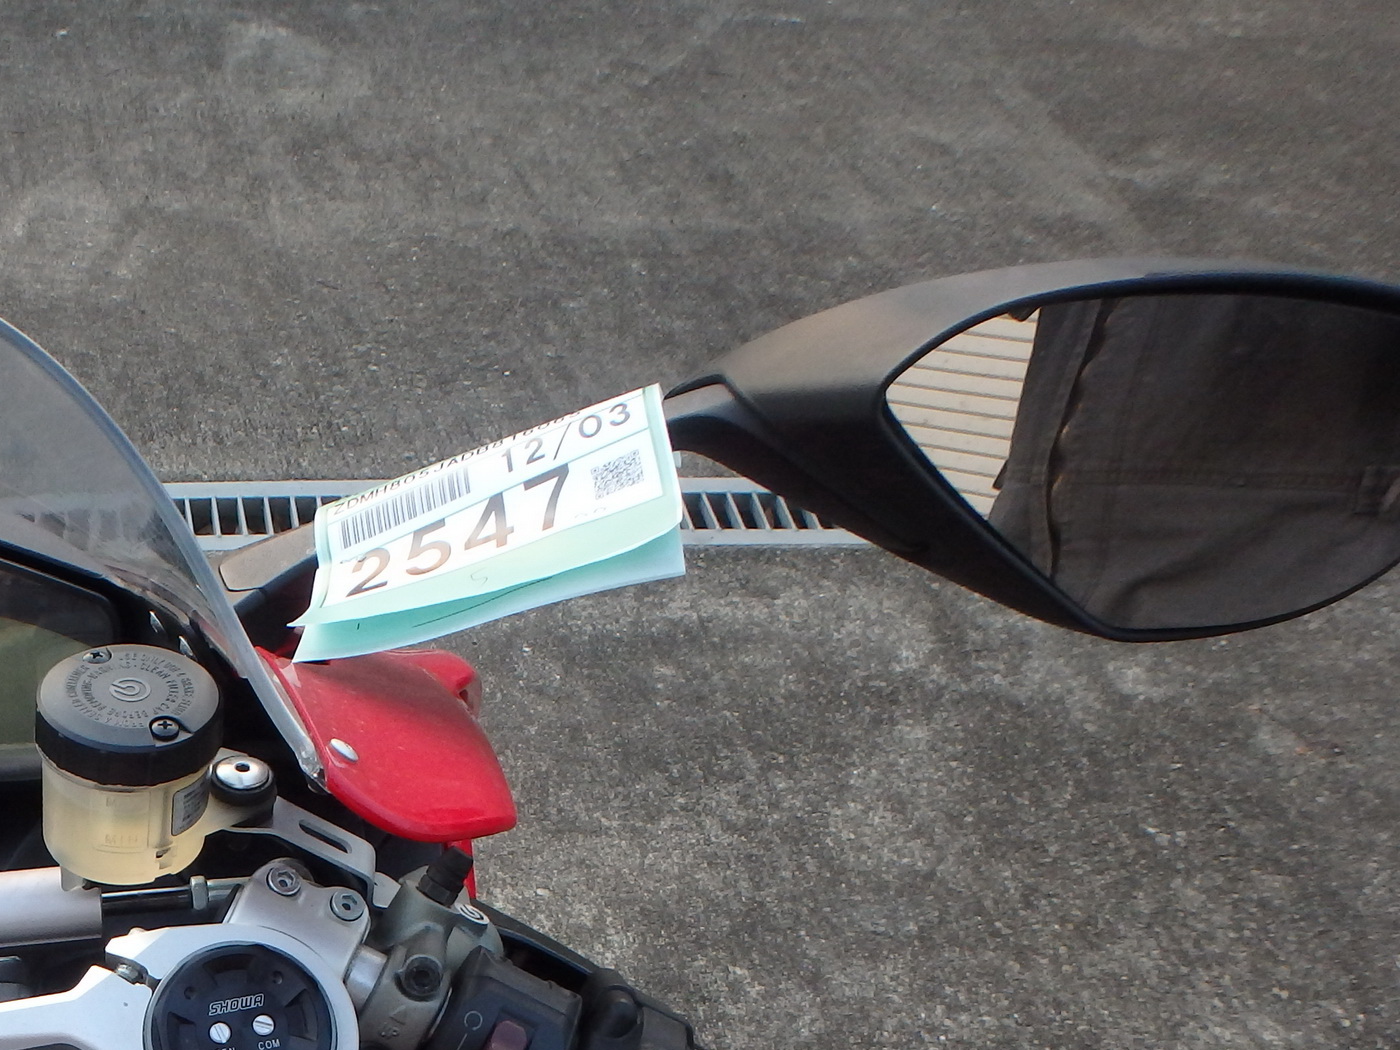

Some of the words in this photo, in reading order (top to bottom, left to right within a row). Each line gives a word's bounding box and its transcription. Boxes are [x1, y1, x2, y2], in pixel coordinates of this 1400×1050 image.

[501, 402, 631, 473] 12/03
[345, 463, 570, 598] 2547
[208, 993, 264, 1016] SHOWA
[258, 1038, 281, 1050] COM
